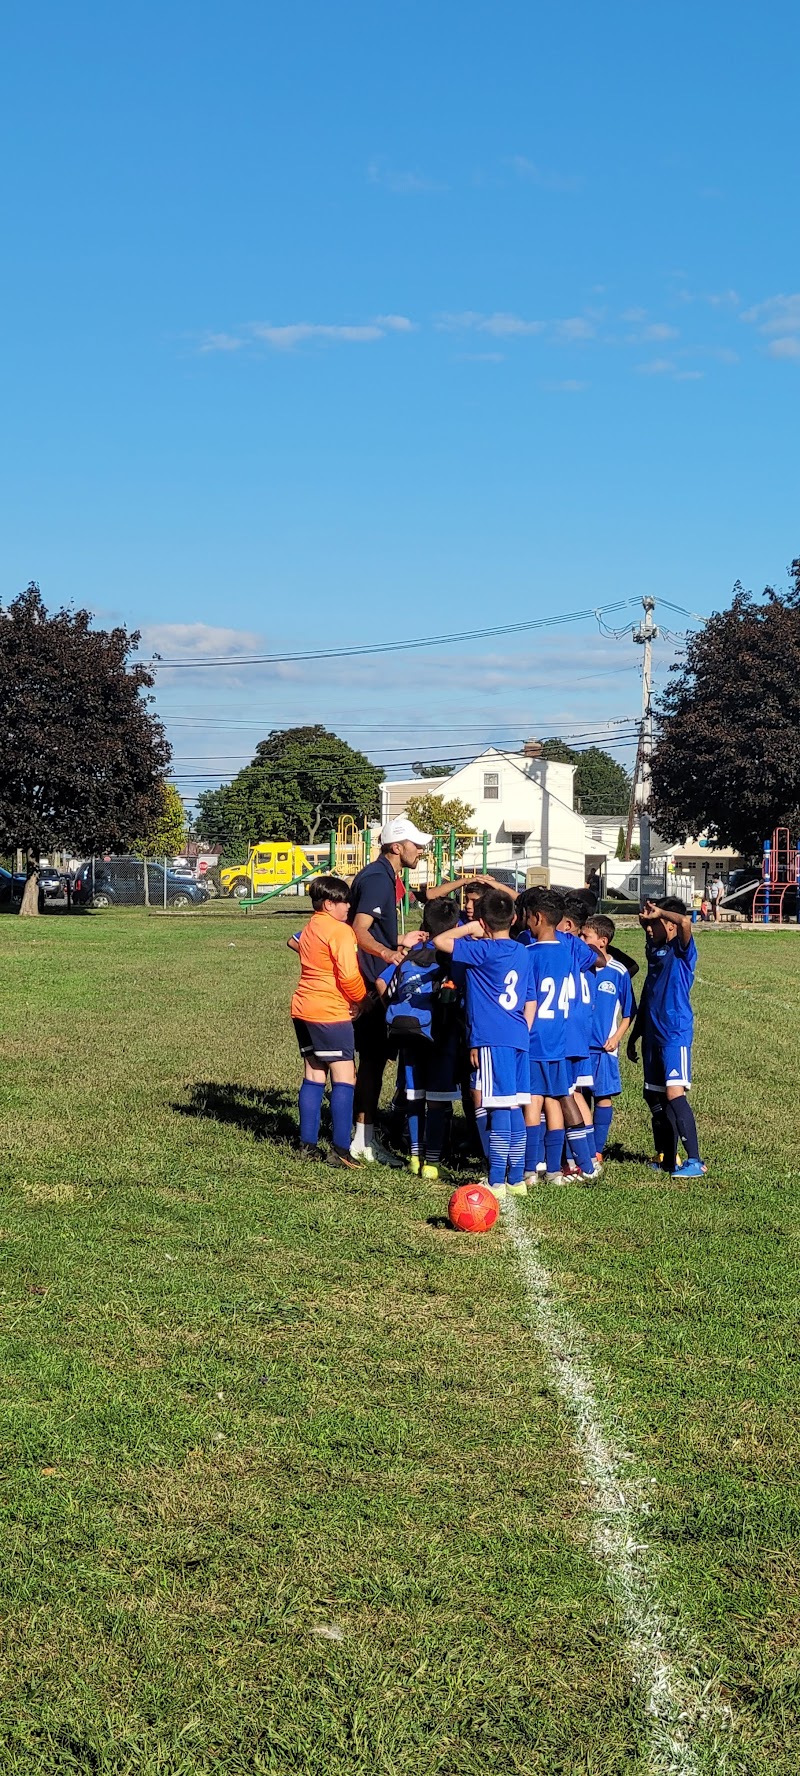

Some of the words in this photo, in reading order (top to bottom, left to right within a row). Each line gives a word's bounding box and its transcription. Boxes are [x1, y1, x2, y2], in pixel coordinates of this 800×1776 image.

[403, 992, 413, 1004] 2
[498, 969, 519, 1011] 3
[537, 976, 570, 1019] 24
